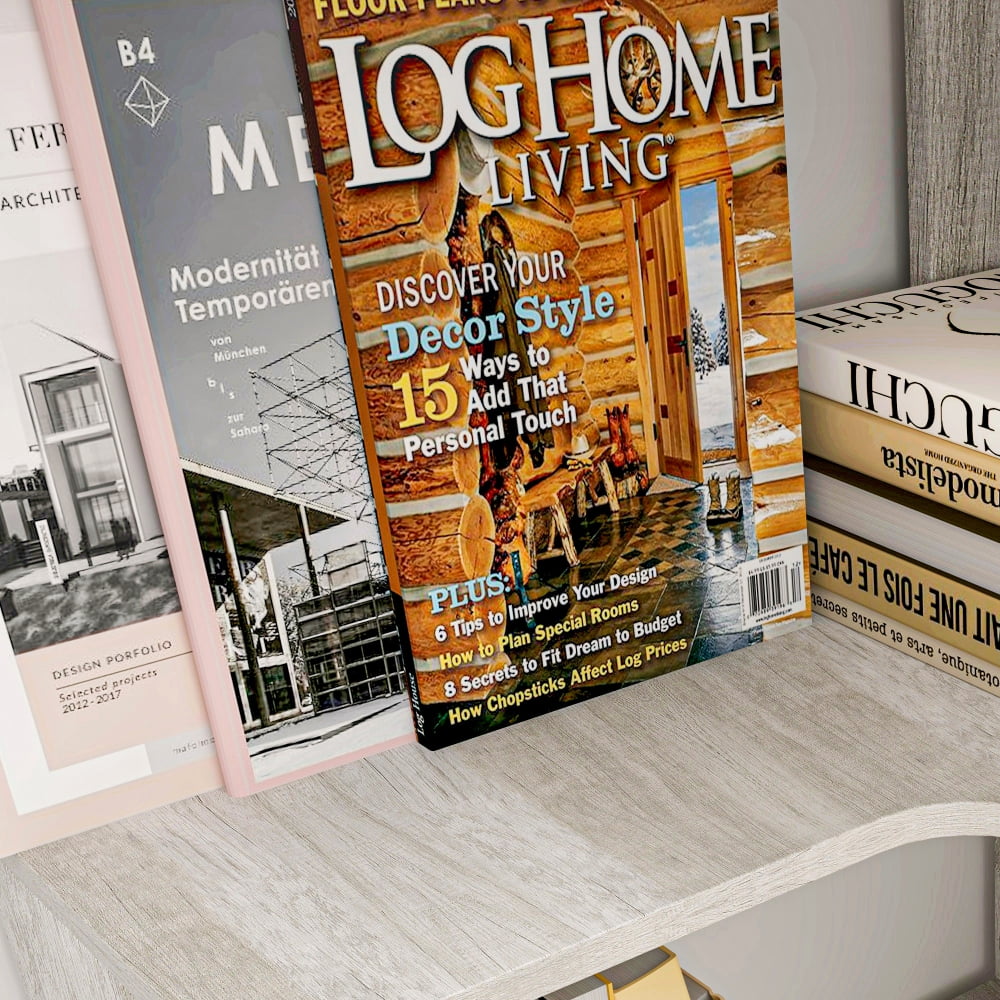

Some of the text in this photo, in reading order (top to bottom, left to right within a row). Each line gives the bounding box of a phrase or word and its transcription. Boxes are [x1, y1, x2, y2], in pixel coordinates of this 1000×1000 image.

[117, 36, 156, 67] B4
[170, 242, 320, 293] Modernität
[376, 248, 567, 314] DISCOVER YOUR
[210, 335, 232, 347] von
[382, 286, 615, 362] Decor Style
[214, 345, 266, 363] München
[460, 343, 550, 384] Ways to
[392, 365, 459, 431] 15
[466, 372, 569, 417] Add That
[403, 400, 578, 463] Personal Touch
[428, 571, 511, 615] PLUS:
[857, 556, 879, 598] LE
[883, 568, 925, 617] FOIS
[434, 564, 658, 642] 6 Tips to Improve Your Design
[851, 610, 887, 638] petits
[929, 588, 968, 637] UNE
[439, 599, 640, 671] How to Plan Special Rooms
[443, 610, 684, 699] 8 Secrets to Fit Dream to Budget
[890, 626, 904, 644] et
[907, 634, 935, 659] arts
[52, 640, 173, 681] DESIGN PORFOLIO
[448, 634, 689, 727] How Chopsticks Affect Log Prices
[59, 669, 158, 703] Selected projects
